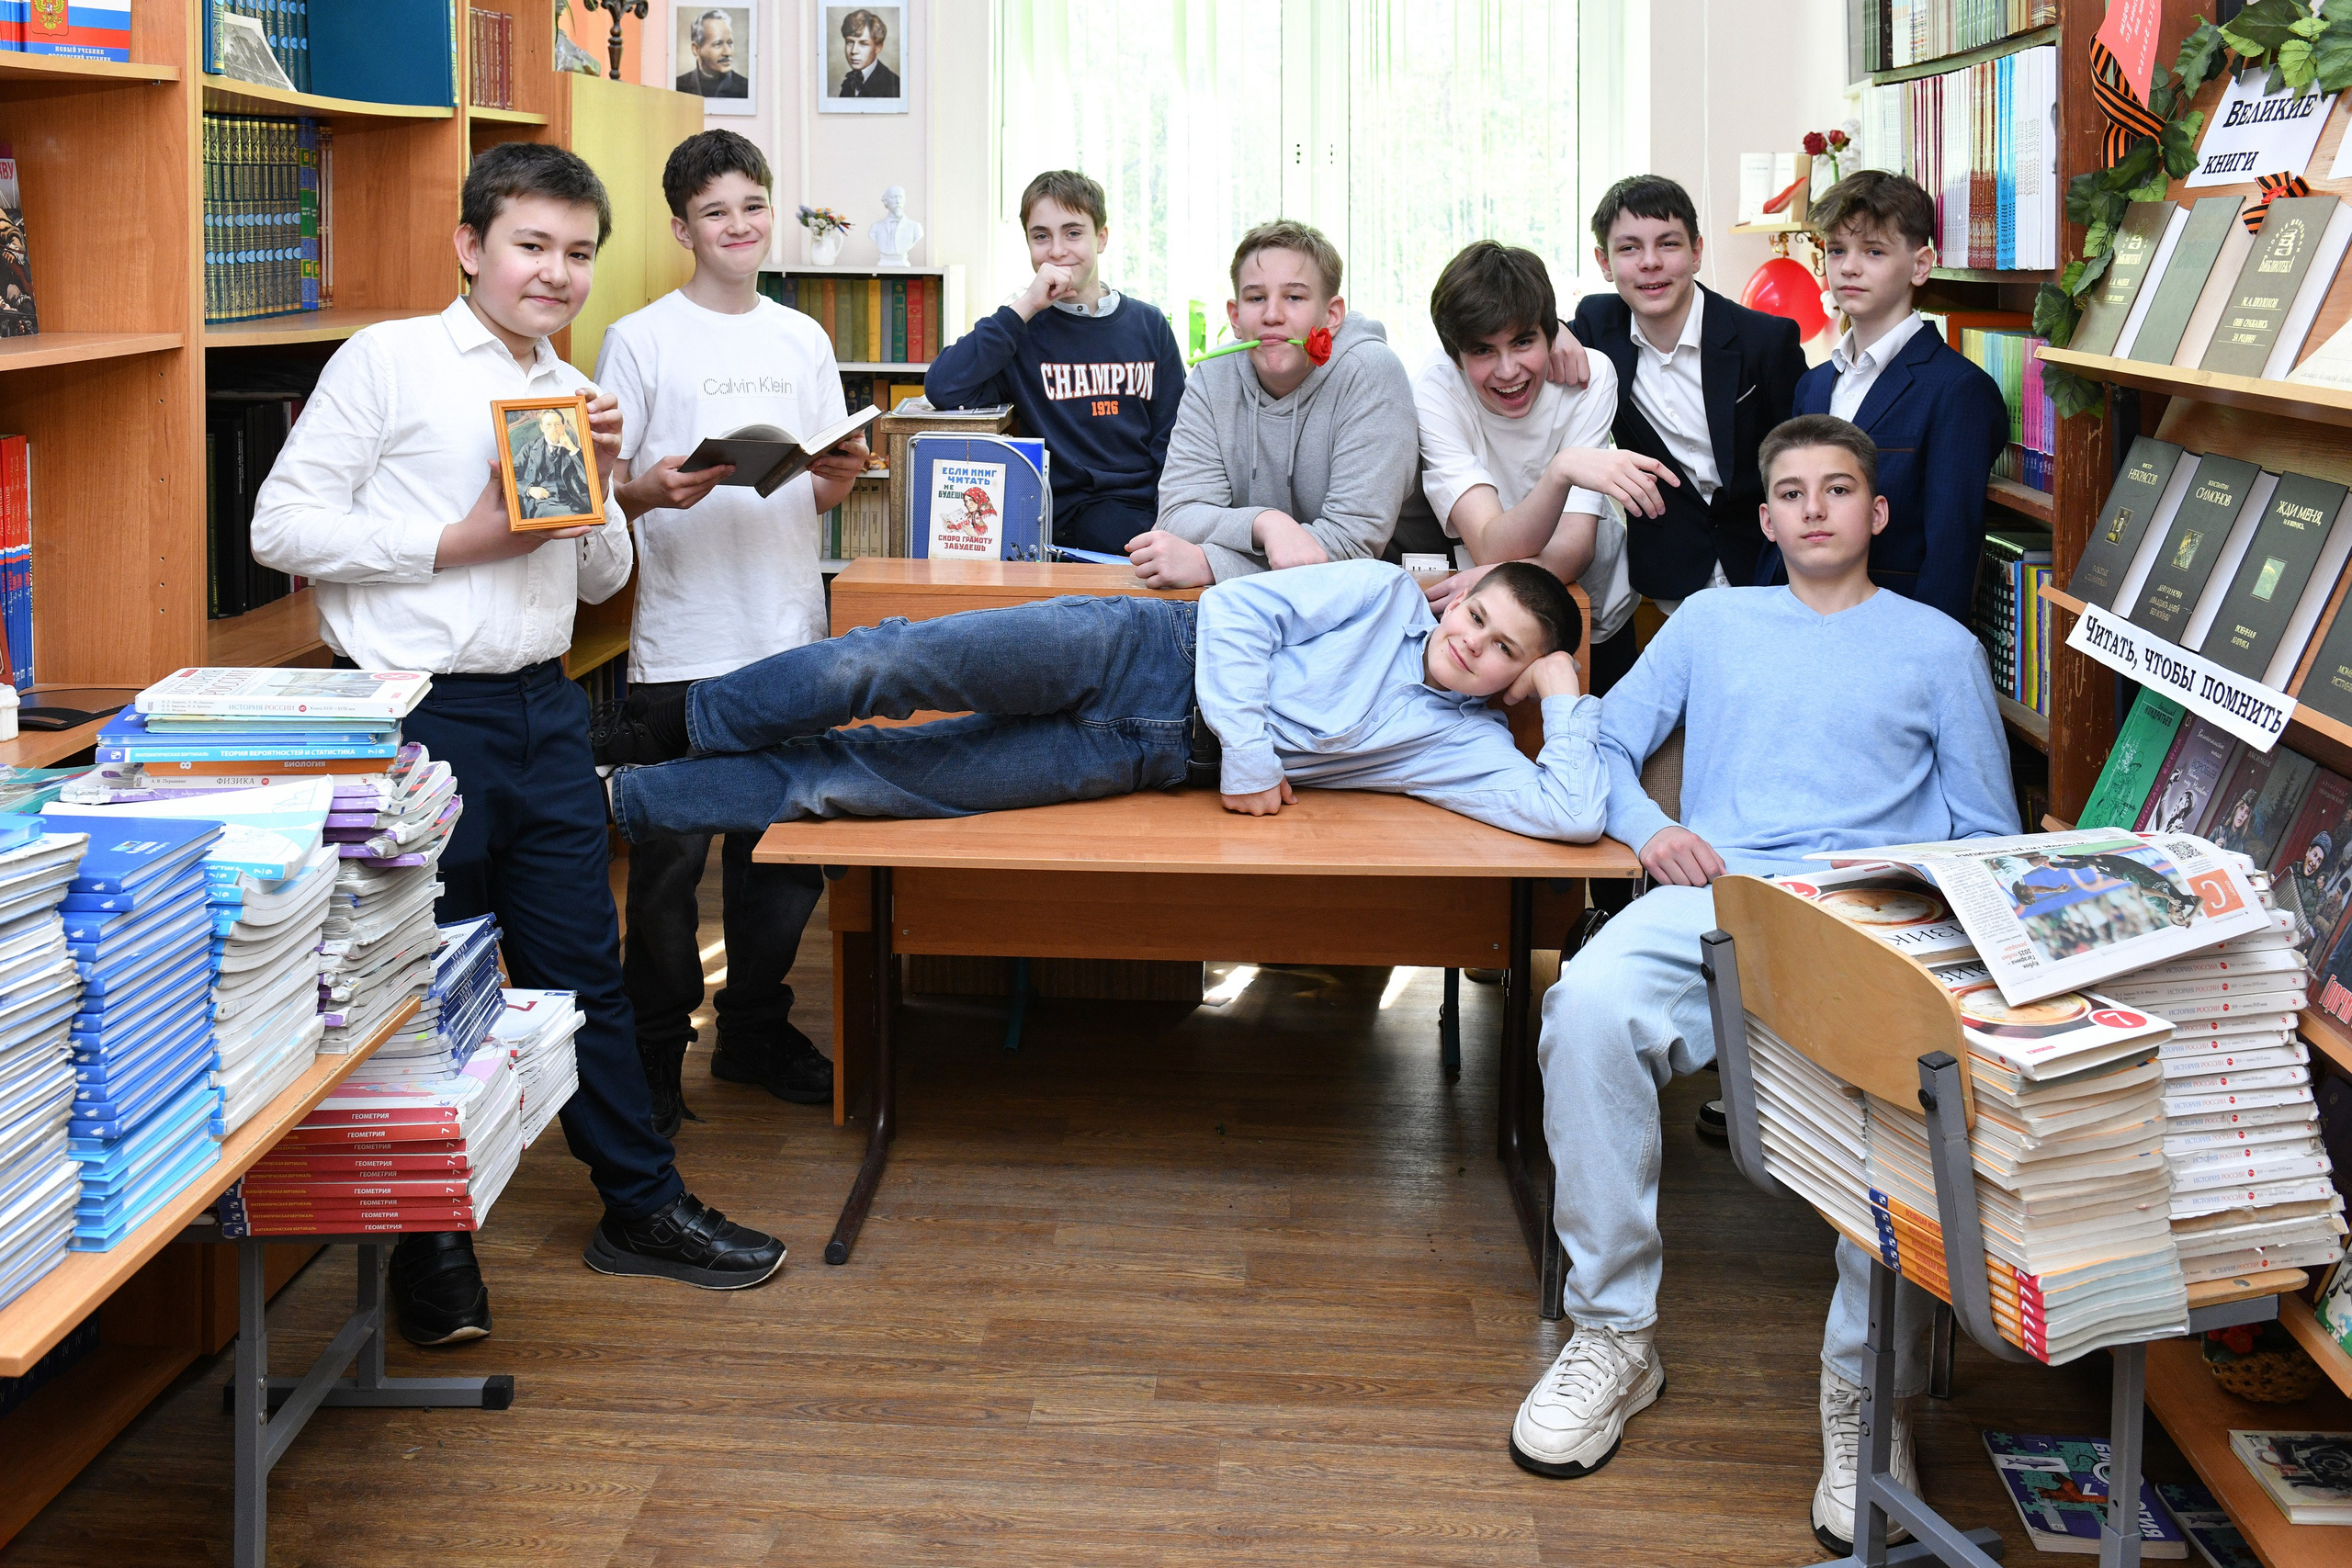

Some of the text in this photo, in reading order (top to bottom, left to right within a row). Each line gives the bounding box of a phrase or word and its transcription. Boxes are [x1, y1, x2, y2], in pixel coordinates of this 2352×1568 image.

[77, 47, 105, 55] УЧЕБНИК
[2201, 151, 2259, 175] КНИГИ
[2258, 255, 2296, 273] БИБЛИОТЕКА
[2253, 298, 2278, 309] ШОЛОХОВ
[704, 377, 792, 395] Calvin Klein
[1040, 360, 1156, 400] CHAMPION
[1091, 400, 1119, 417] 1976
[943, 467, 968, 476] ЕСЛИ
[2128, 468, 2159, 486] НЕКРАСОВ
[948, 476, 990, 485] ЧИТАТЬ
[2196, 486, 2233, 507] СИМОНОВ
[2277, 500, 2324, 527] ЖДИ МЕНЯ,
[944, 542, 986, 551] ЗАБУДЕШЬ
[2234, 624, 2256, 639] ВОЕННАЯ
[2231, 636, 2251, 650] ЛИРИКА
[2144, 647, 2196, 693] ЧТОБЫ
[2199, 674, 2284, 734] ПОМНИТЬ
[2143, 705, 2173, 728] КОНДРАТЬЕВ
[249, 748, 303, 757] ВЕРОЯТНОСТЕЙ
[2247, 750, 2271, 768] ВАСИЛЬЕВ
[2018, 948, 2032, 957] 2025
[2011, 955, 2036, 964] Гагарина
[2165, 964, 2193, 974] ИСТОРИЯ
[2193, 964, 2218, 972] РОССИИ
[2167, 986, 2195, 995] ИСТОРИЯ
[2168, 1006, 2220, 1016] ИСТОРИЯ РОССИИ
[2101, 1012, 2135, 1027] 7
[2185, 1043, 2209, 1051] РОССИИ
[2174, 1063, 2199, 1071] ИСТОРИЯ
[2174, 1101, 2201, 1110] ИСТОРИЯ
[347, 1131, 386, 1139] ГЕОМЕТРИЯ
[2185, 1136, 2211, 1145] ИСТОРИЯ
[2192, 1155, 2219, 1164] ИСТОРИЯ
[2193, 1172, 2245, 1184] ИСТОРИЯ РОССИИ
[2192, 1196, 2221, 1204] ИСТОРИЯ
[2211, 1262, 2259, 1274] ИСТОРИЯ РОССИИ
[2016, 1269, 2029, 1281] 7
[2020, 1286, 2032, 1299] 7
[2021, 1300, 2034, 1314] 7
[2023, 1314, 2035, 1329] 7
[2024, 1329, 2036, 1344] 7
[2026, 1342, 2038, 1356] 7
